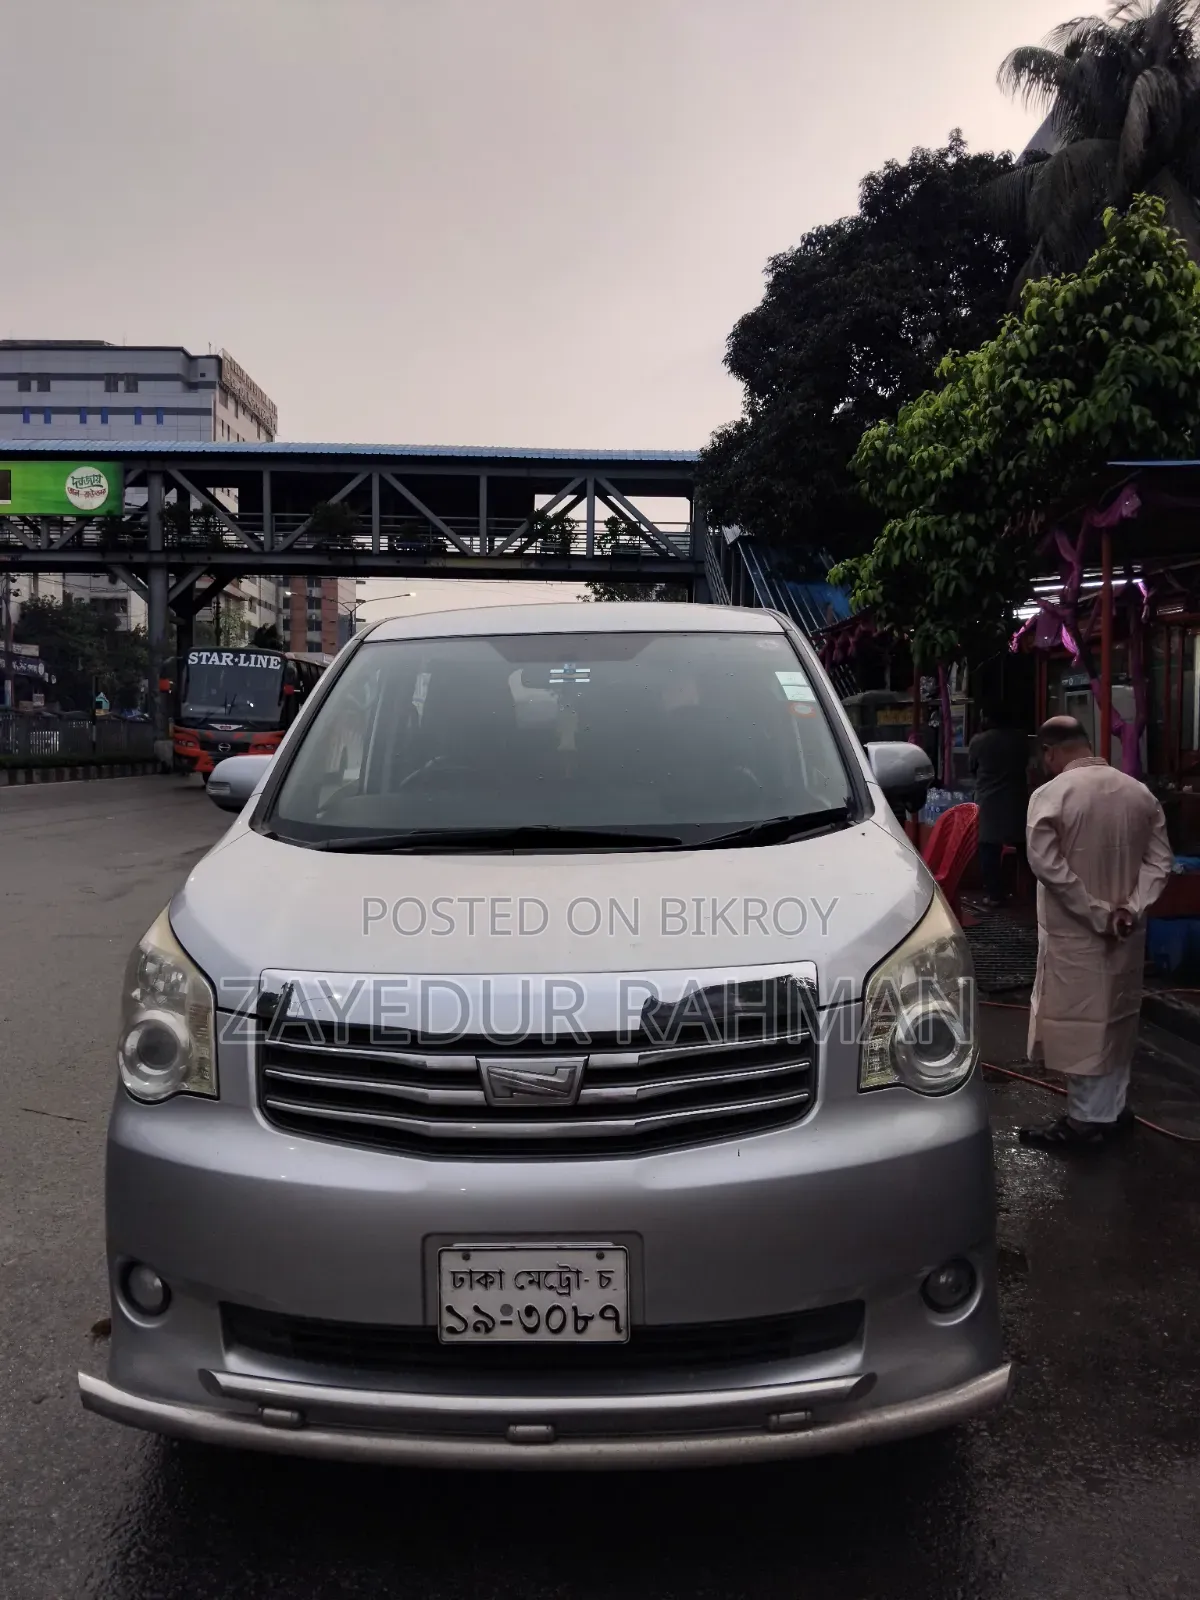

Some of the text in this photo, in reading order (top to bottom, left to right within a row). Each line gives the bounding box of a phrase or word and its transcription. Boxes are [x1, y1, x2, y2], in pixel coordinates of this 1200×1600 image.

[188, 651, 282, 670] STAR LINE
[449, 1268, 505, 1291] ঢাকা
[445, 1303, 623, 1335] ১৯-৩০৮৭
